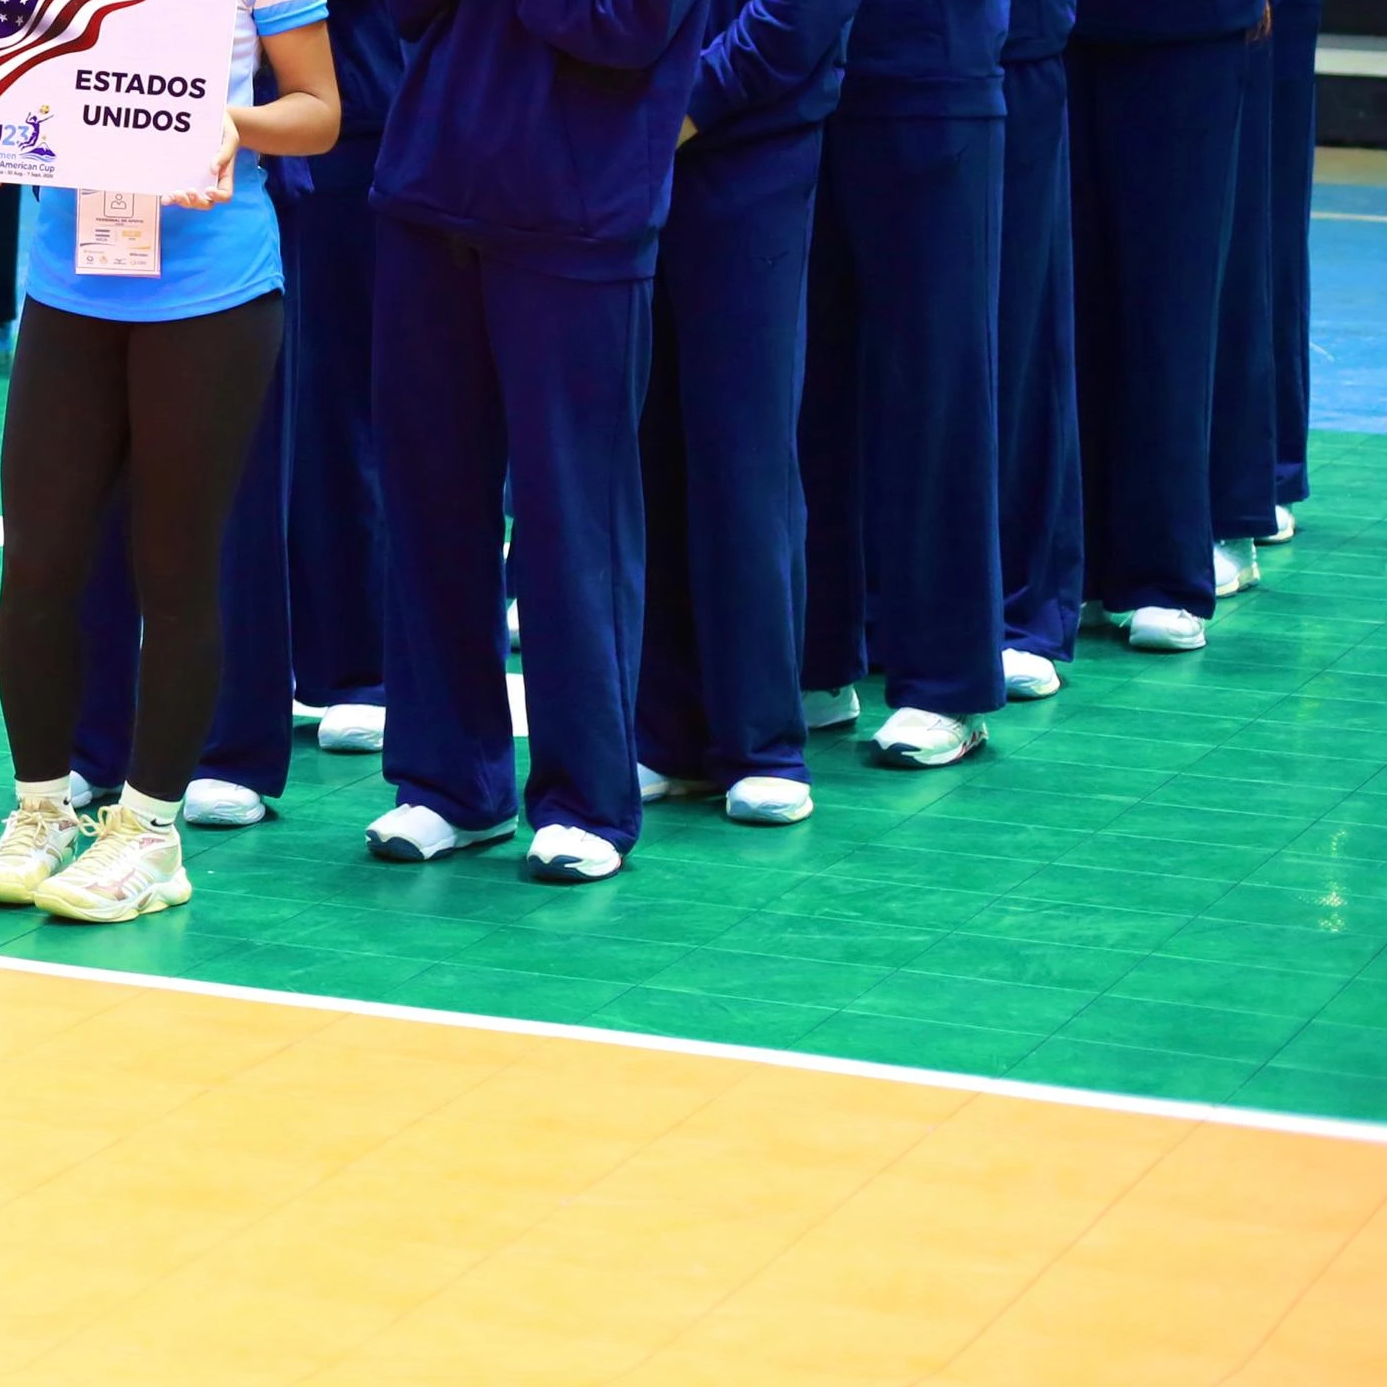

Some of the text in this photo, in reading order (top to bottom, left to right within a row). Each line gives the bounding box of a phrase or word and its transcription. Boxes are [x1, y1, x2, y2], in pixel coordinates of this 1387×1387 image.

[75, 69, 207, 99] ESTADOS
[82, 104, 192, 133] UNIDOS
[0, 160, 38, 171] American
[39, 163, 56, 173] Cup
